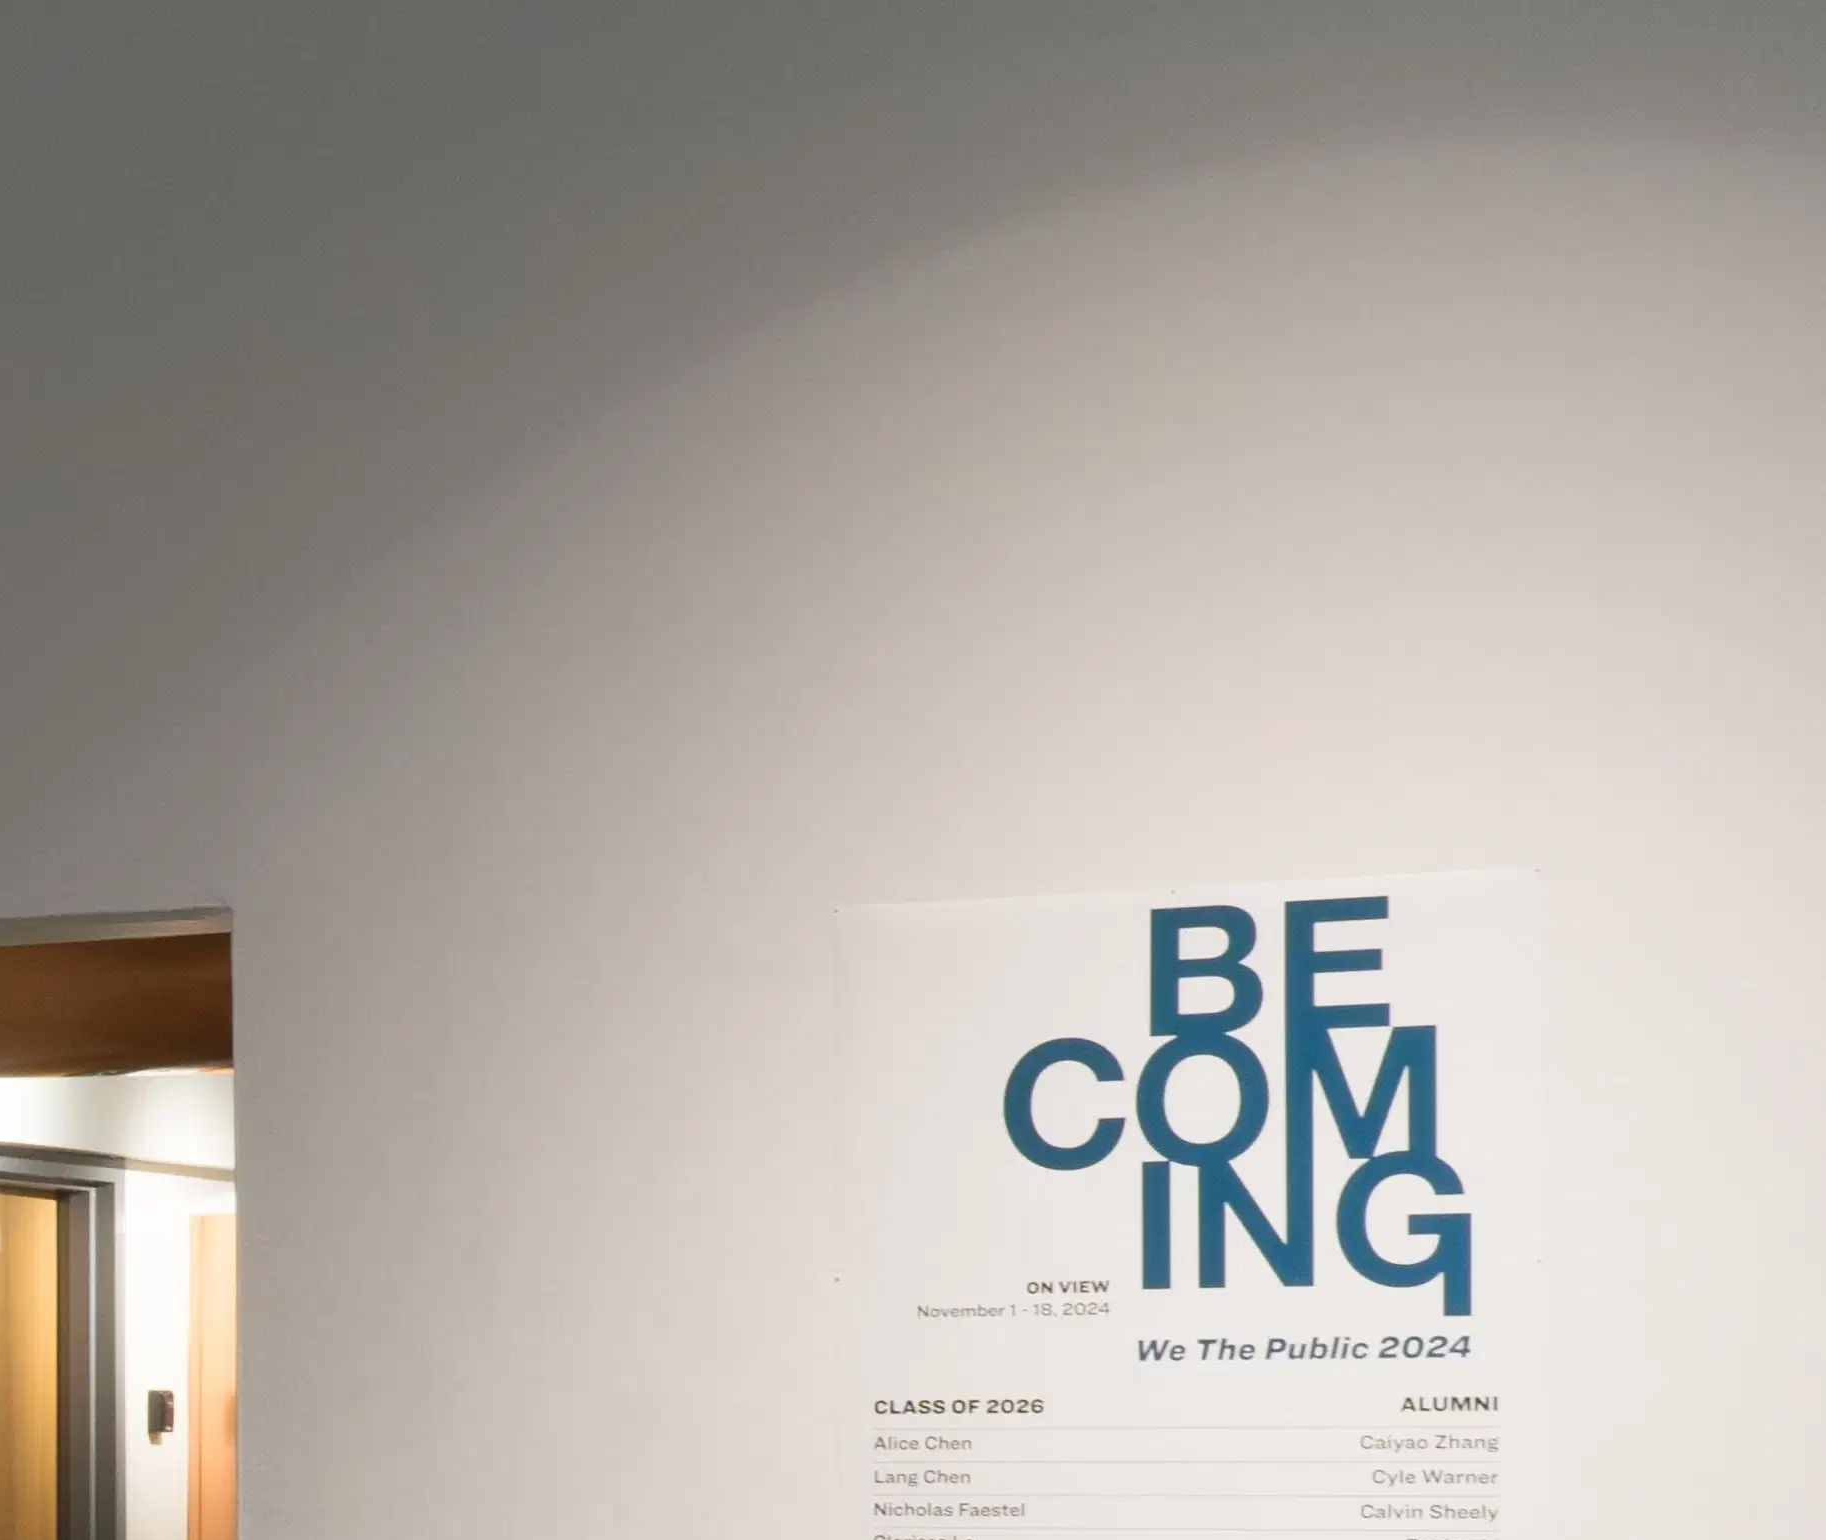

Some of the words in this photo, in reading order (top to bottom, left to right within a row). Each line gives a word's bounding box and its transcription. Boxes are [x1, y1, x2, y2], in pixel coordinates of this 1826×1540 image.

[1026, 1281, 1053, 1294] ON
[1058, 1280, 1109, 1293] VIEW
[916, 1304, 1005, 1318] November
[1008, 1303, 1015, 1316] 1
[1062, 1301, 1110, 1315] 2024
[1137, 1339, 1185, 1361] We
[1197, 1338, 1255, 1360] The
[1264, 1336, 1368, 1359] Public
[1377, 1335, 1470, 1358] 2024
[874, 1399, 945, 1414] CLASS
[951, 1399, 980, 1414] OF
[986, 1398, 1044, 1413] 2026
[1400, 1396, 1497, 1411] ALUMNI
[873, 1436, 919, 1450] Alice
[924, 1435, 972, 1450] Chen
[1359, 1434, 1428, 1452] Caiyao
[1434, 1434, 1499, 1452] Zhang
[873, 1470, 918, 1487] Lang
[923, 1469, 971, 1484] Chen
[1372, 1469, 1416, 1487] Cyle
[1421, 1469, 1498, 1484] Warner
[873, 1502, 953, 1516] Nicholas
[958, 1502, 1025, 1517] Faestel
[1360, 1503, 1423, 1519] Calvin
[1428, 1503, 1498, 1522] Sheely
